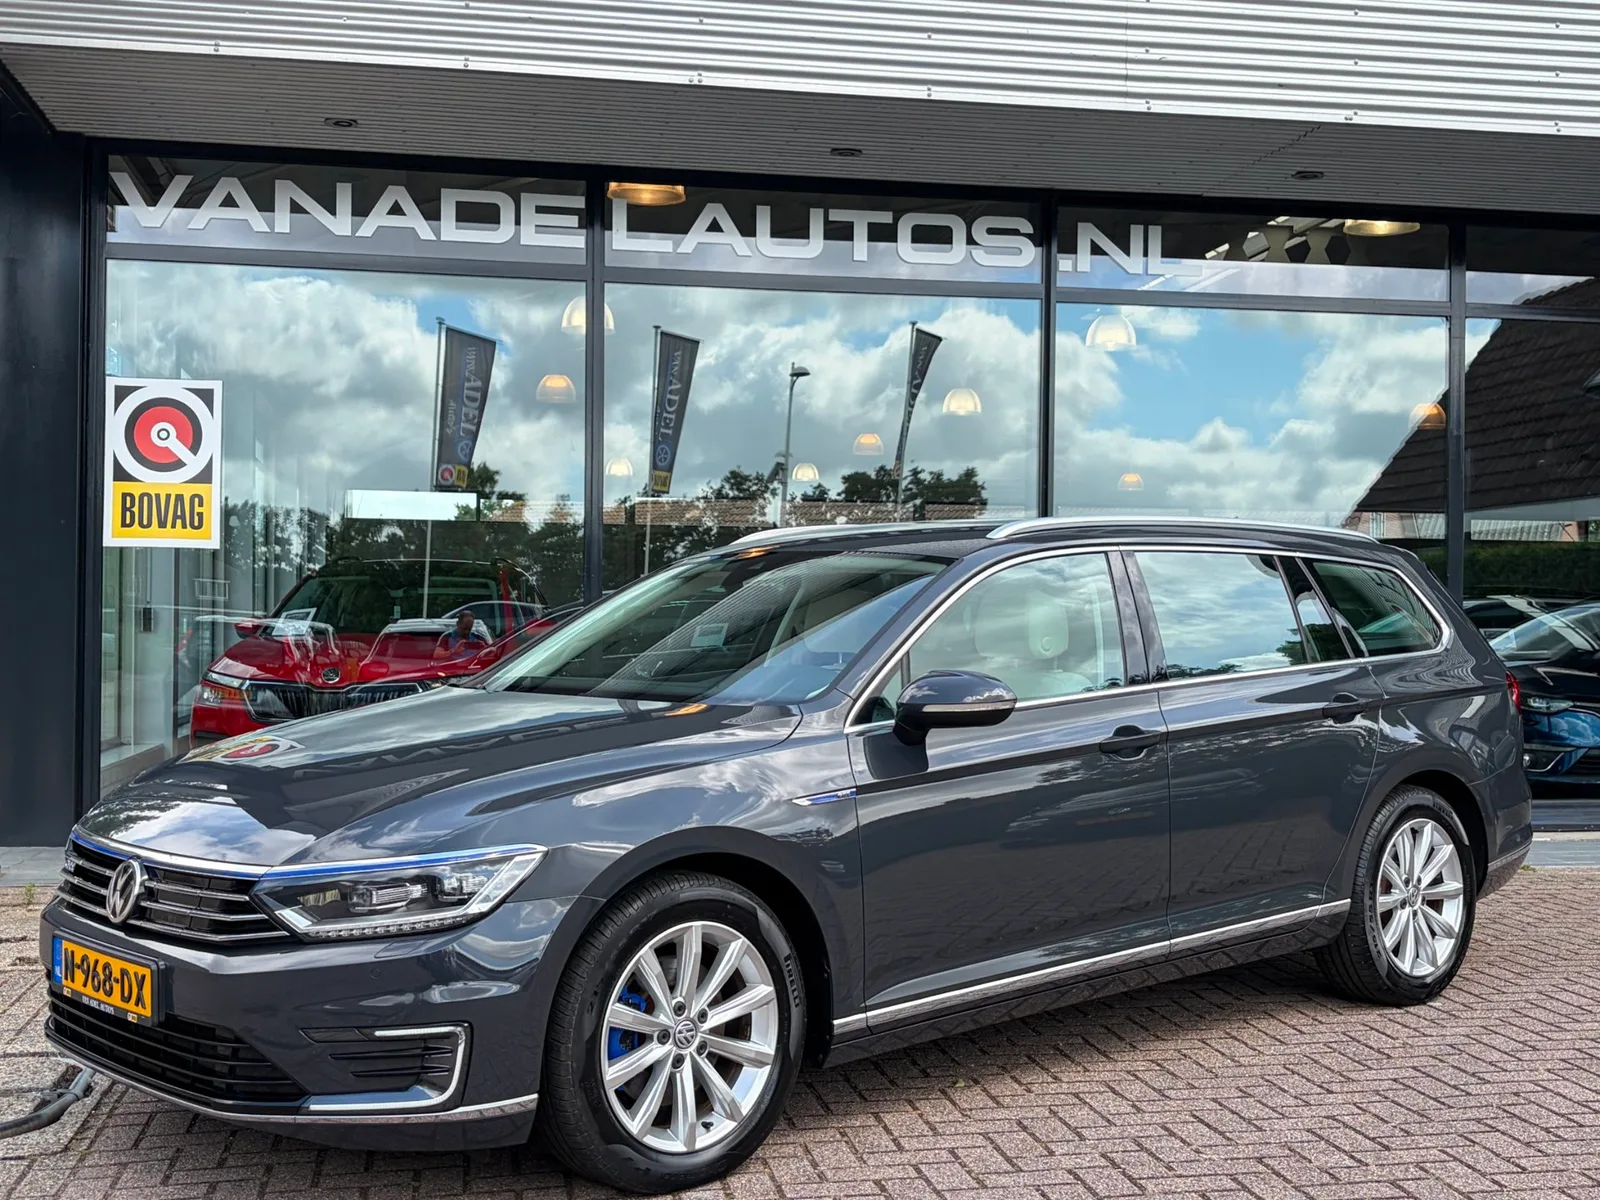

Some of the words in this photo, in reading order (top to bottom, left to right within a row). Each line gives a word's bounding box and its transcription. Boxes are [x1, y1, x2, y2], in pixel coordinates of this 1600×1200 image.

[659, 378, 682, 441] ADEL
[120, 492, 204, 531] BOVAG
[54, 965, 62, 977] NL
[64, 947, 146, 1010] N-968-DX
[783, 953, 800, 1008] PIRELLI
